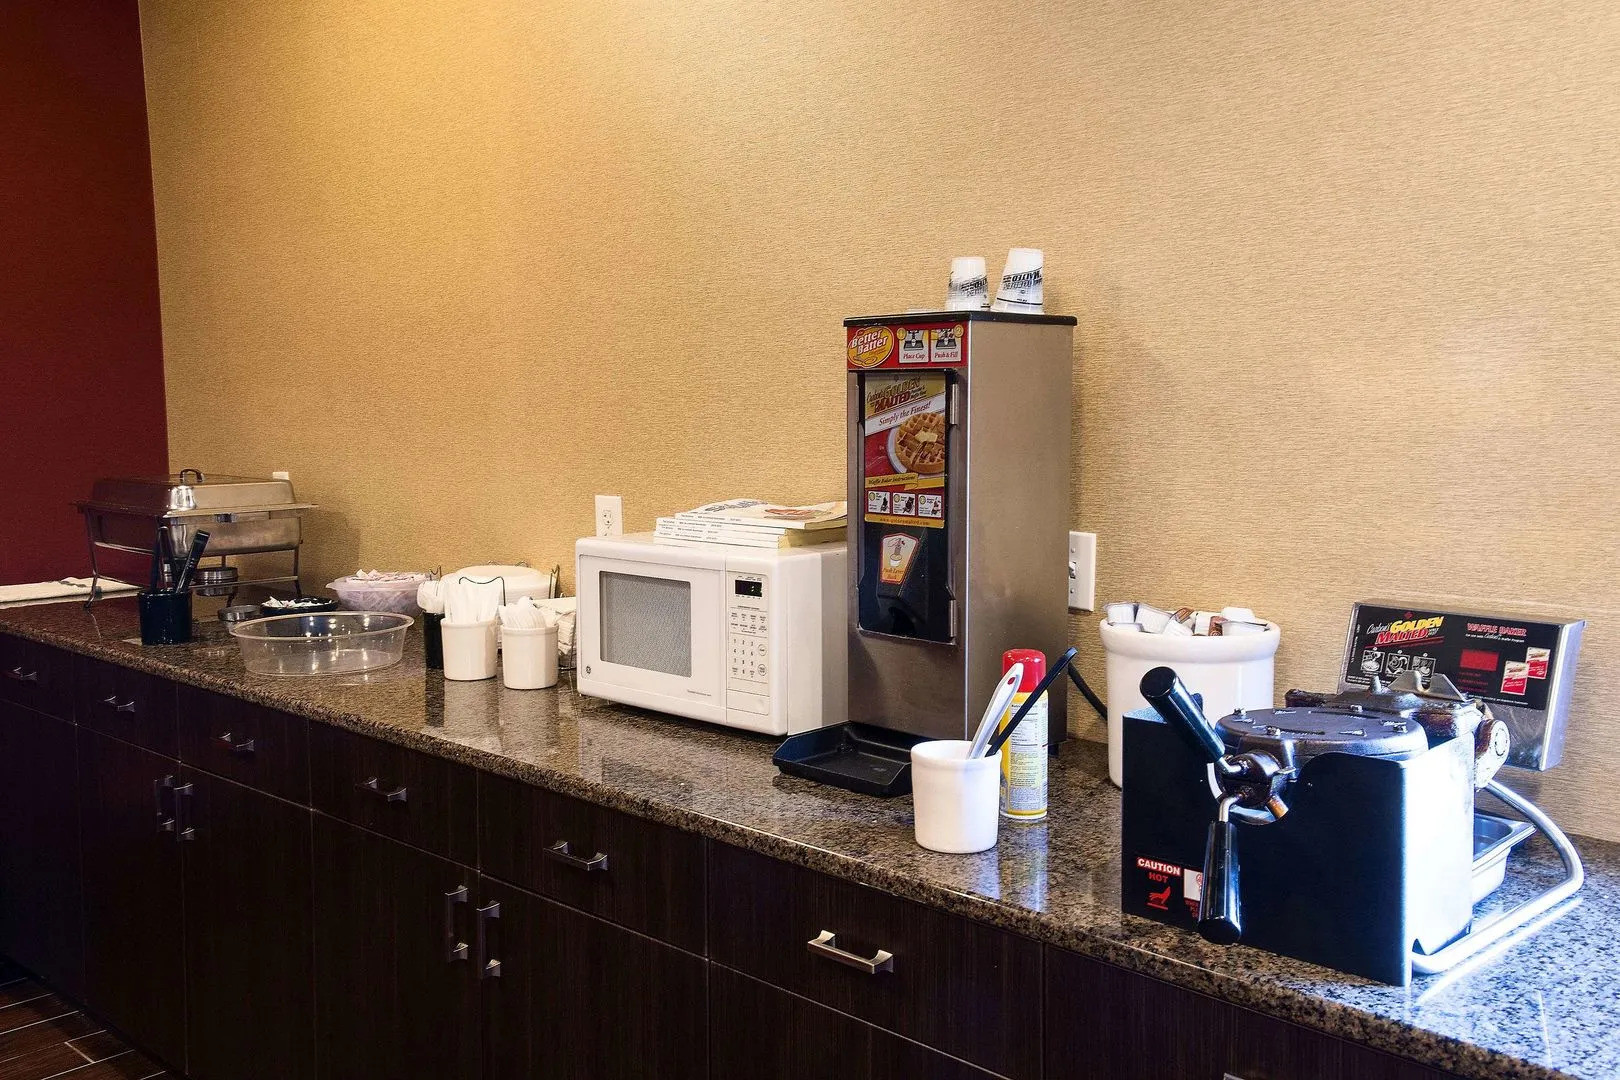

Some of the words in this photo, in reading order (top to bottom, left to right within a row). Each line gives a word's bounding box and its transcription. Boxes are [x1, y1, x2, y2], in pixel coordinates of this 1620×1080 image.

[850, 329, 883, 349] Better
[857, 336, 888, 355] Batter
[874, 391, 911, 413] MALTED
[879, 412, 899, 425] Simply
[900, 408, 910, 417] the
[910, 401, 932, 414] Finest!
[1389, 616, 1444, 633] GOLDEN
[1467, 622, 1498, 634] WAFFLE
[1499, 626, 1527, 637] BAKER
[1375, 628, 1429, 644] MALTED
[1137, 858, 1180, 876] CAUTION
[1148, 872, 1169, 884] HOT
